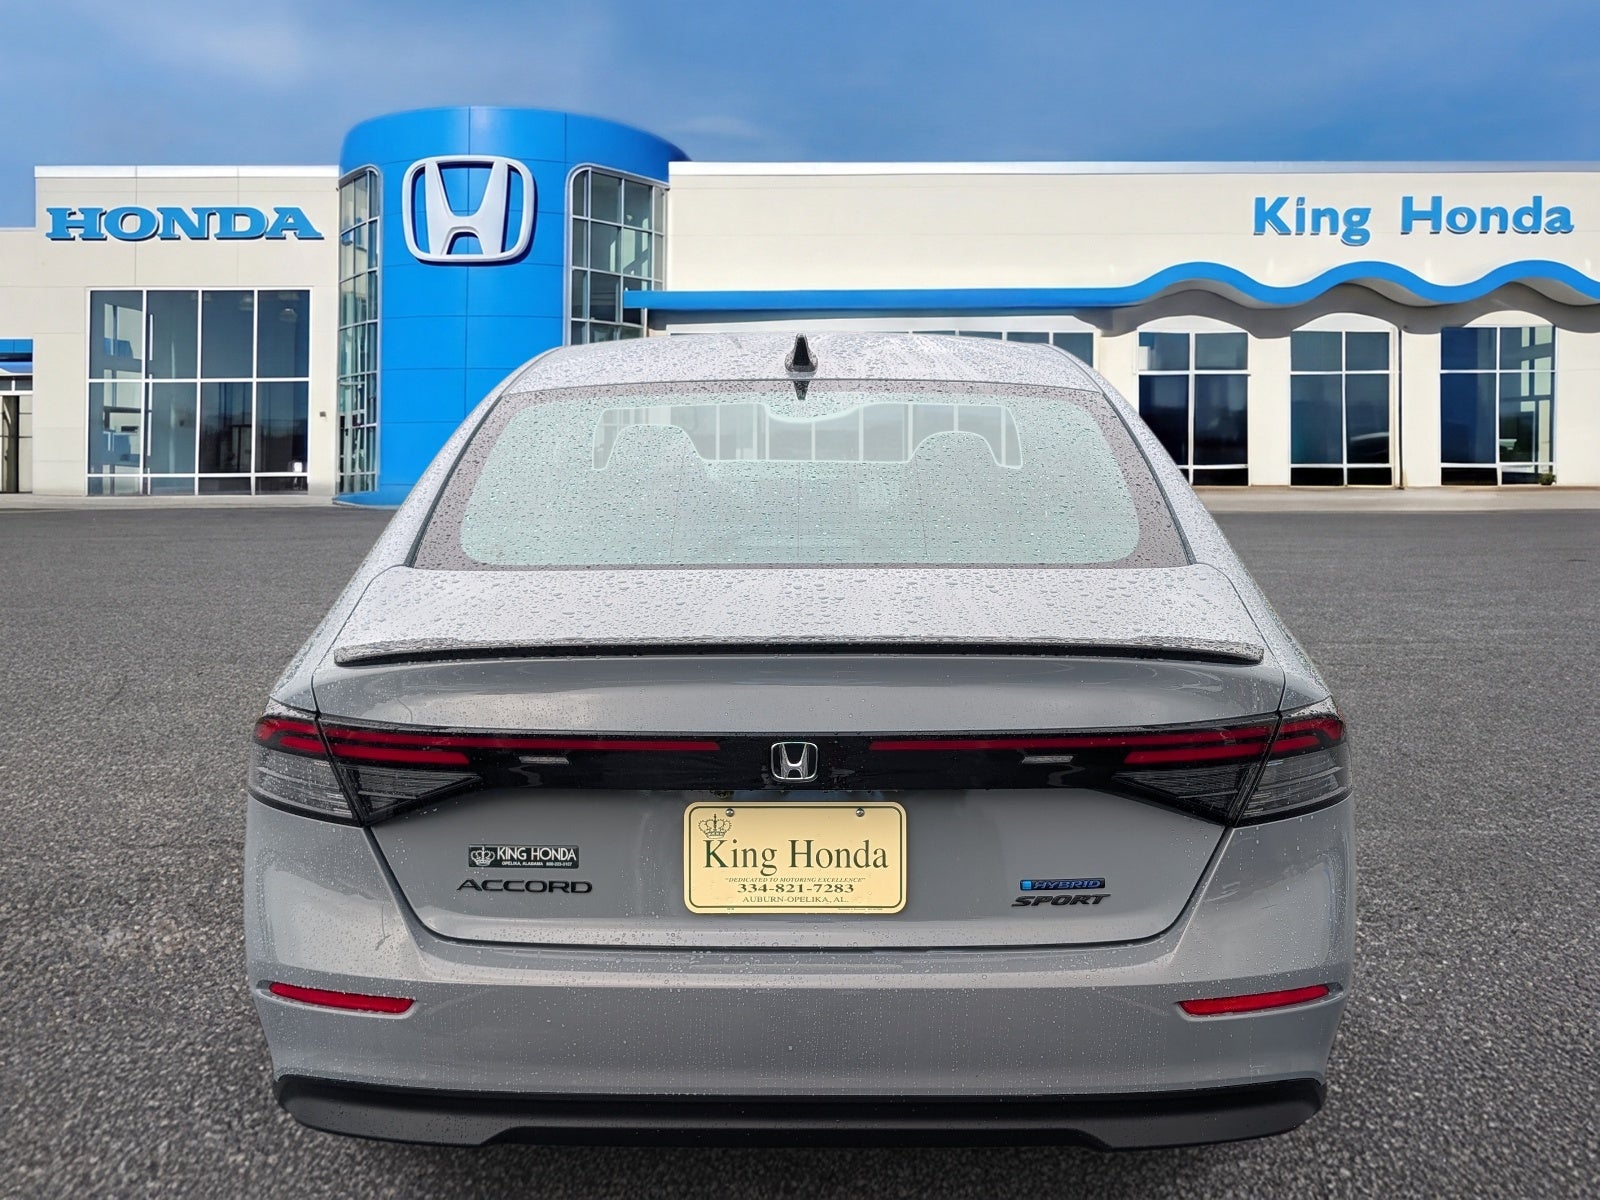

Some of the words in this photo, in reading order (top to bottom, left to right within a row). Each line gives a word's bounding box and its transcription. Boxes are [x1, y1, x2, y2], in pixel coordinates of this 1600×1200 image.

[45, 206, 324, 241] HONDA
[1253, 196, 1372, 247] King
[1400, 195, 1575, 235] Honda
[497, 846, 527, 860] KING
[531, 847, 577, 861] HONDA
[703, 838, 777, 876] King
[788, 839, 888, 869] Honda
[456, 879, 593, 894] ACCORD
[737, 883, 855, 893] 334-821-7283
[1033, 880, 1101, 889] HYBRID
[1011, 893, 1111, 907] SPORT
